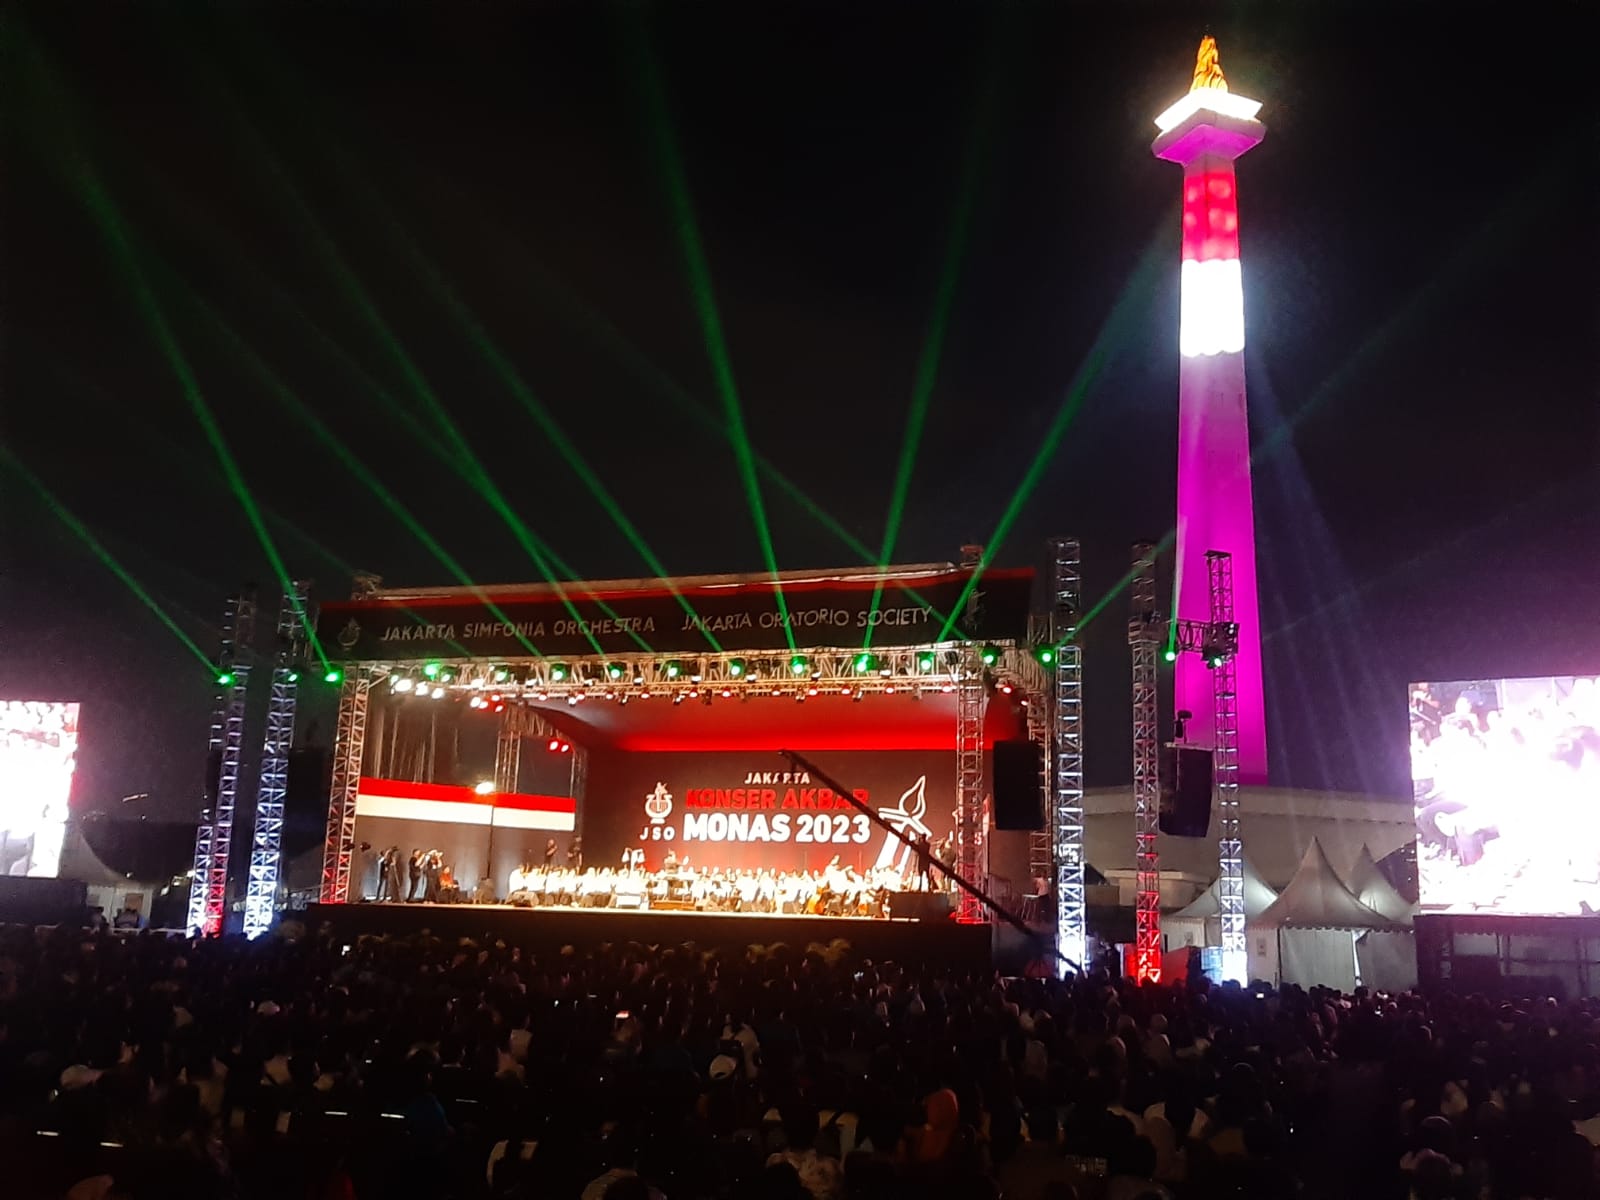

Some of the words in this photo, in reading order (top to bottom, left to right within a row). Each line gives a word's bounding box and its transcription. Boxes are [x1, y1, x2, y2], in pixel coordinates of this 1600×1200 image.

[381, 622, 455, 642] JAKARTA
[463, 618, 545, 638] SIMFONIA
[553, 615, 656, 636] ORCHESTRA
[681, 611, 752, 632] JAKARTA
[759, 607, 850, 627] ORATORIO
[856, 605, 934, 627] SOCIETY
[685, 788, 777, 810] KONSER
[683, 813, 791, 842] MONAS
[796, 814, 871, 843] 2023
